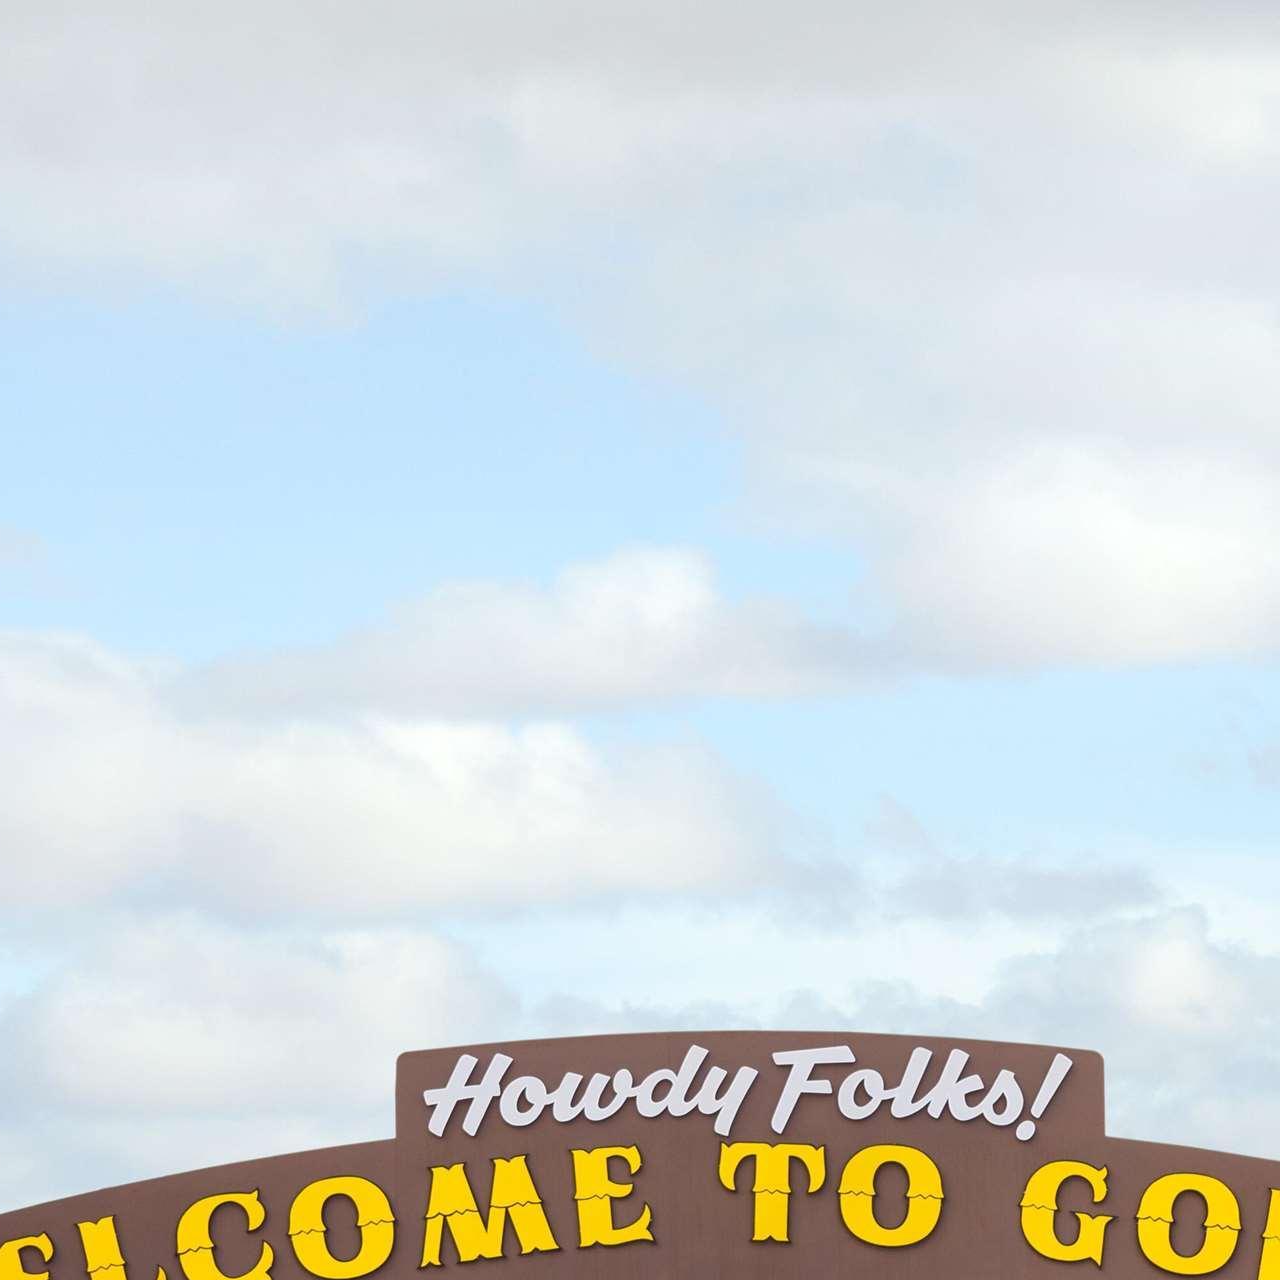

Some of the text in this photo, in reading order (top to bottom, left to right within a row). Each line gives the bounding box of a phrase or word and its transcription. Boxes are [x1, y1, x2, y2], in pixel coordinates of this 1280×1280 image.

[423, 1044, 1073, 1141] Howdy Folks!
[718, 1141, 945, 1248] TO
